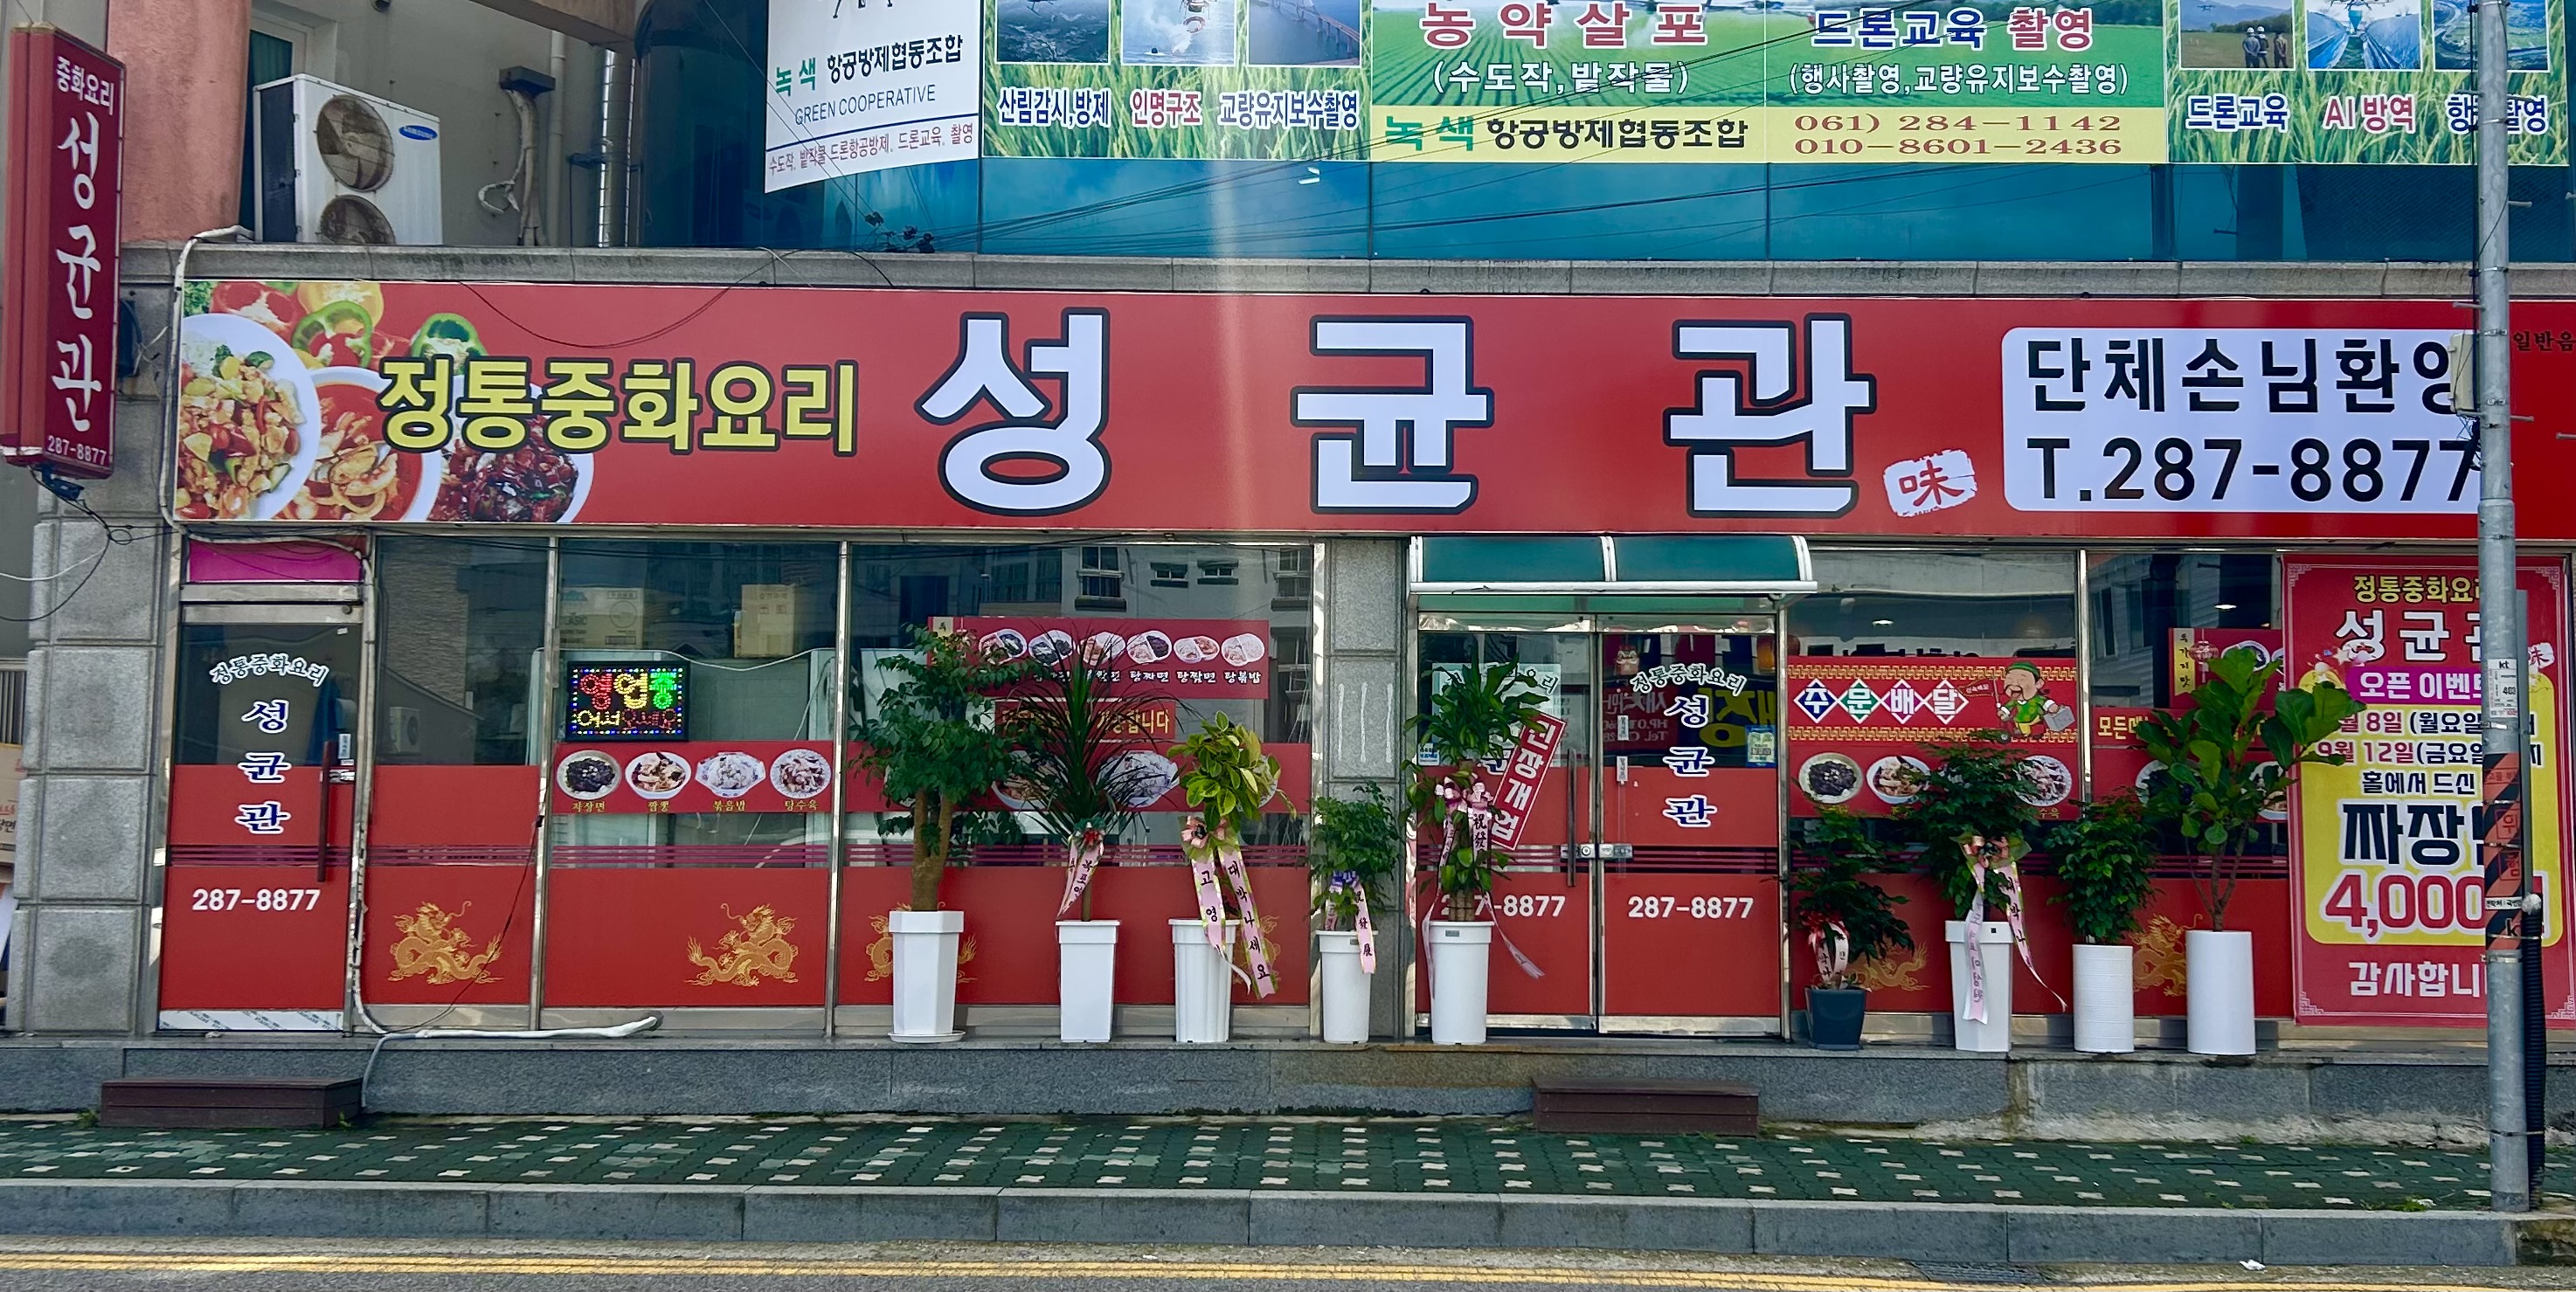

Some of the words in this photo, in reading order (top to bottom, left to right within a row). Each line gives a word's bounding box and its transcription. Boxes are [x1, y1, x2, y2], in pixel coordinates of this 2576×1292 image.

[1422, 3, 1707, 47] 농약살포
[1813, 9, 1986, 49] 드론교육
[2010, 8, 2093, 50] 촬영
[775, 56, 816, 96] 녹색
[827, 34, 963, 84] 항공방제협동조합
[1790, 64, 2128, 94] (행사촬영,교량유지보수촬영)
[56, 56, 114, 115] 중화요리
[795, 101, 835, 126] GREEN
[839, 85, 936, 115] COOPERATIVE
[999, 90, 1110, 128] 산림감시,방제
[1134, 91, 1201, 125] 인명구조
[1220, 92, 1357, 128] 교량유지보수촬영
[1795, 114, 1880, 133] 061)
[1899, 115, 2121, 131] 284-1142
[2188, 95, 2288, 132] 드론교육
[2326, 99, 2353, 128] AI
[2364, 96, 2414, 133] 방역
[951, 122, 973, 145] 촬영
[1386, 115, 1474, 151] 녹색
[1487, 118, 1748, 149] 항공방제협동조합
[1795, 138, 2122, 155] 010-8601-2436
[52, 111, 101, 432] 성균관
[378, 357, 858, 456] 정통중화요리
[915, 307, 1876, 517] 성균관
[47, 435, 107, 465] 287-8877
[1899, 459, 1964, 508] 味
[2026, 437, 2476, 501] T.287-8877
[2354, 576, 2479, 603] 정통중화요
[210, 653, 329, 687] 정통중화요리
[1630, 663, 1747, 696] 정통중화요리
[2359, 673, 2412, 699] 오픈
[579, 672, 677, 709] 영업중
[1804, 687, 1957, 715] 주문배달
[2366, 712, 2402, 734] 8일
[233, 699, 292, 834] 성균관
[1663, 694, 1718, 828] 성균관
[2362, 771, 2426, 794] 홀에서
[2434, 773, 2475, 794] 드신
[2039, 807, 2060, 819] 수육
[192, 888, 321, 911] 287-8877
[1441, 895, 1565, 917] 27-8877
[1629, 896, 1754, 918] 287-8877
[2325, 874, 2544, 938] 4,000
[1228, 860, 1271, 980] 대박나세요
[2349, 962, 2487, 998] 감사합니
